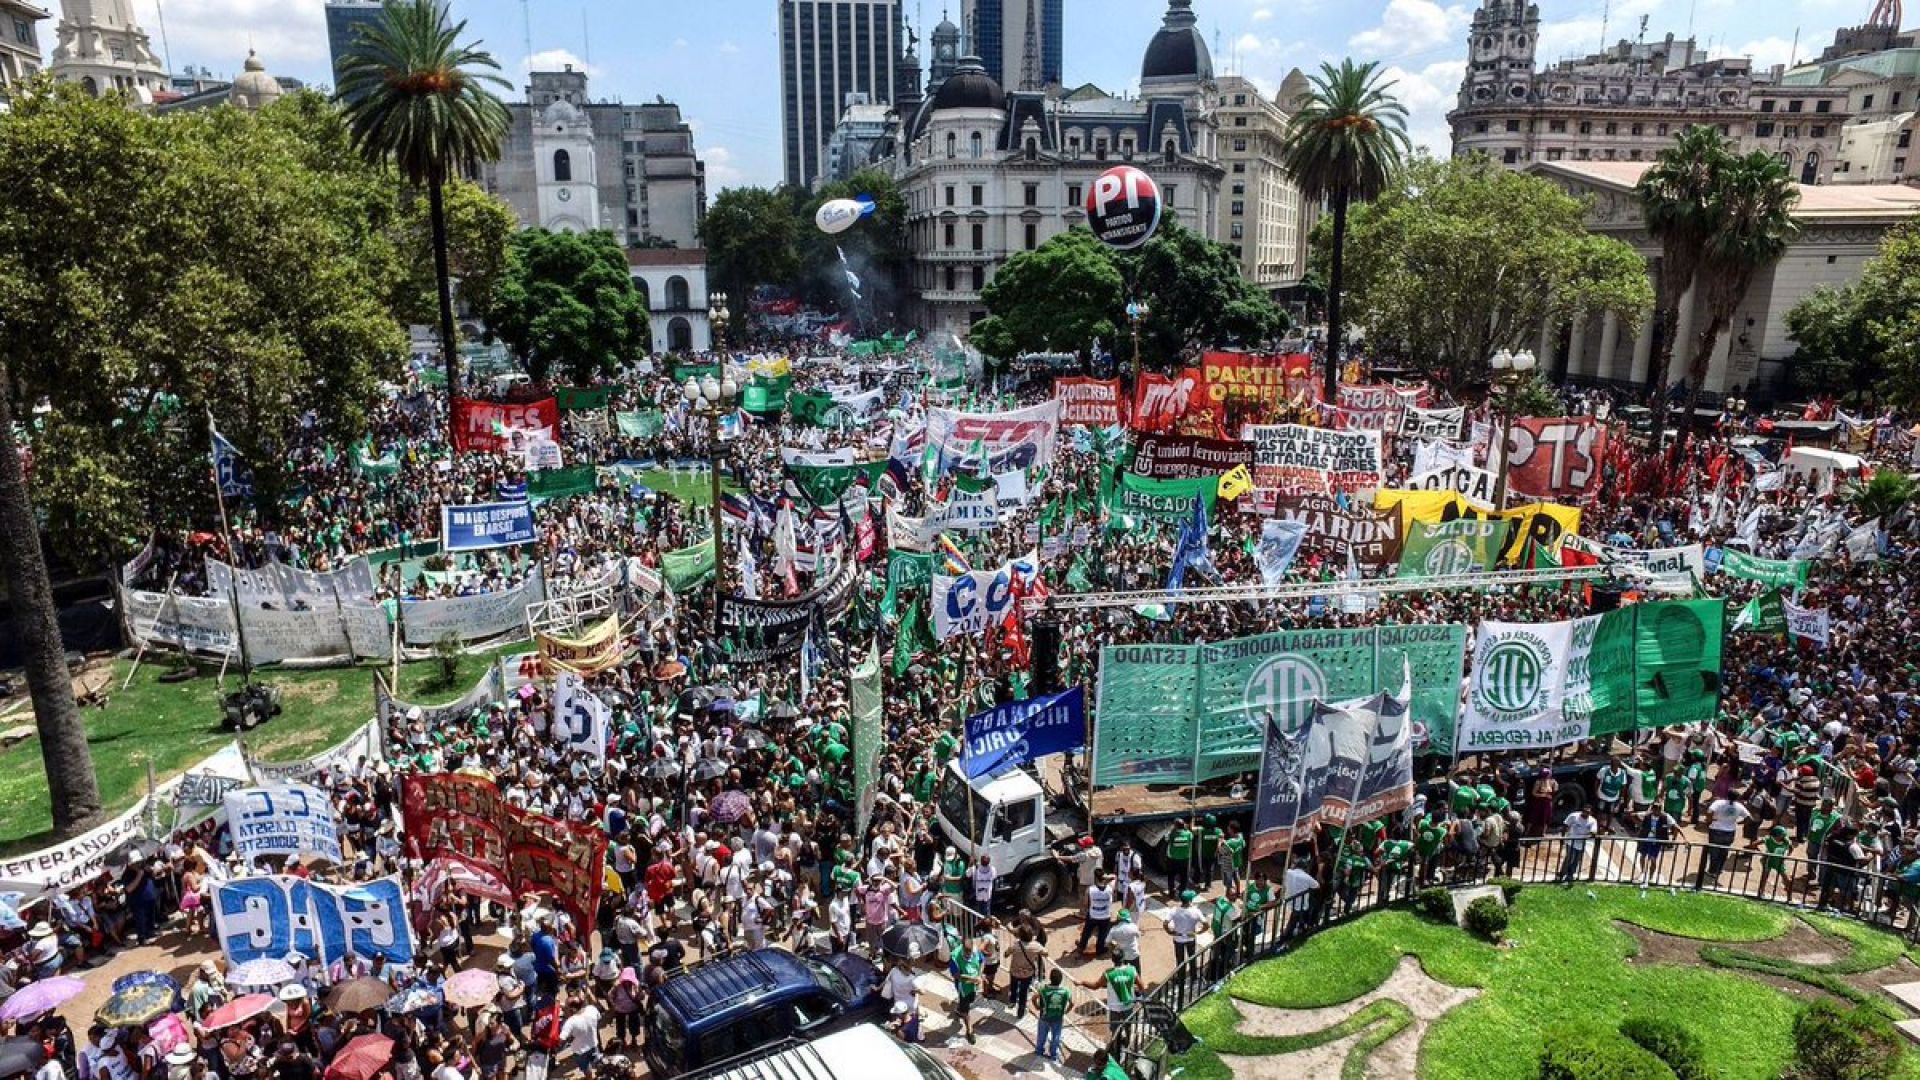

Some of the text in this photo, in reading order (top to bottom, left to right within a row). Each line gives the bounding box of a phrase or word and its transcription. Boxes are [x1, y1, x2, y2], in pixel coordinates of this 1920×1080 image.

[1158, 443, 1190, 458] unión
[1301, 442, 1320, 454] DE
[473, 511, 489, 523] LOS
[474, 520, 514, 536] EN ARSAT
[1424, 523, 1494, 538] SALUD
